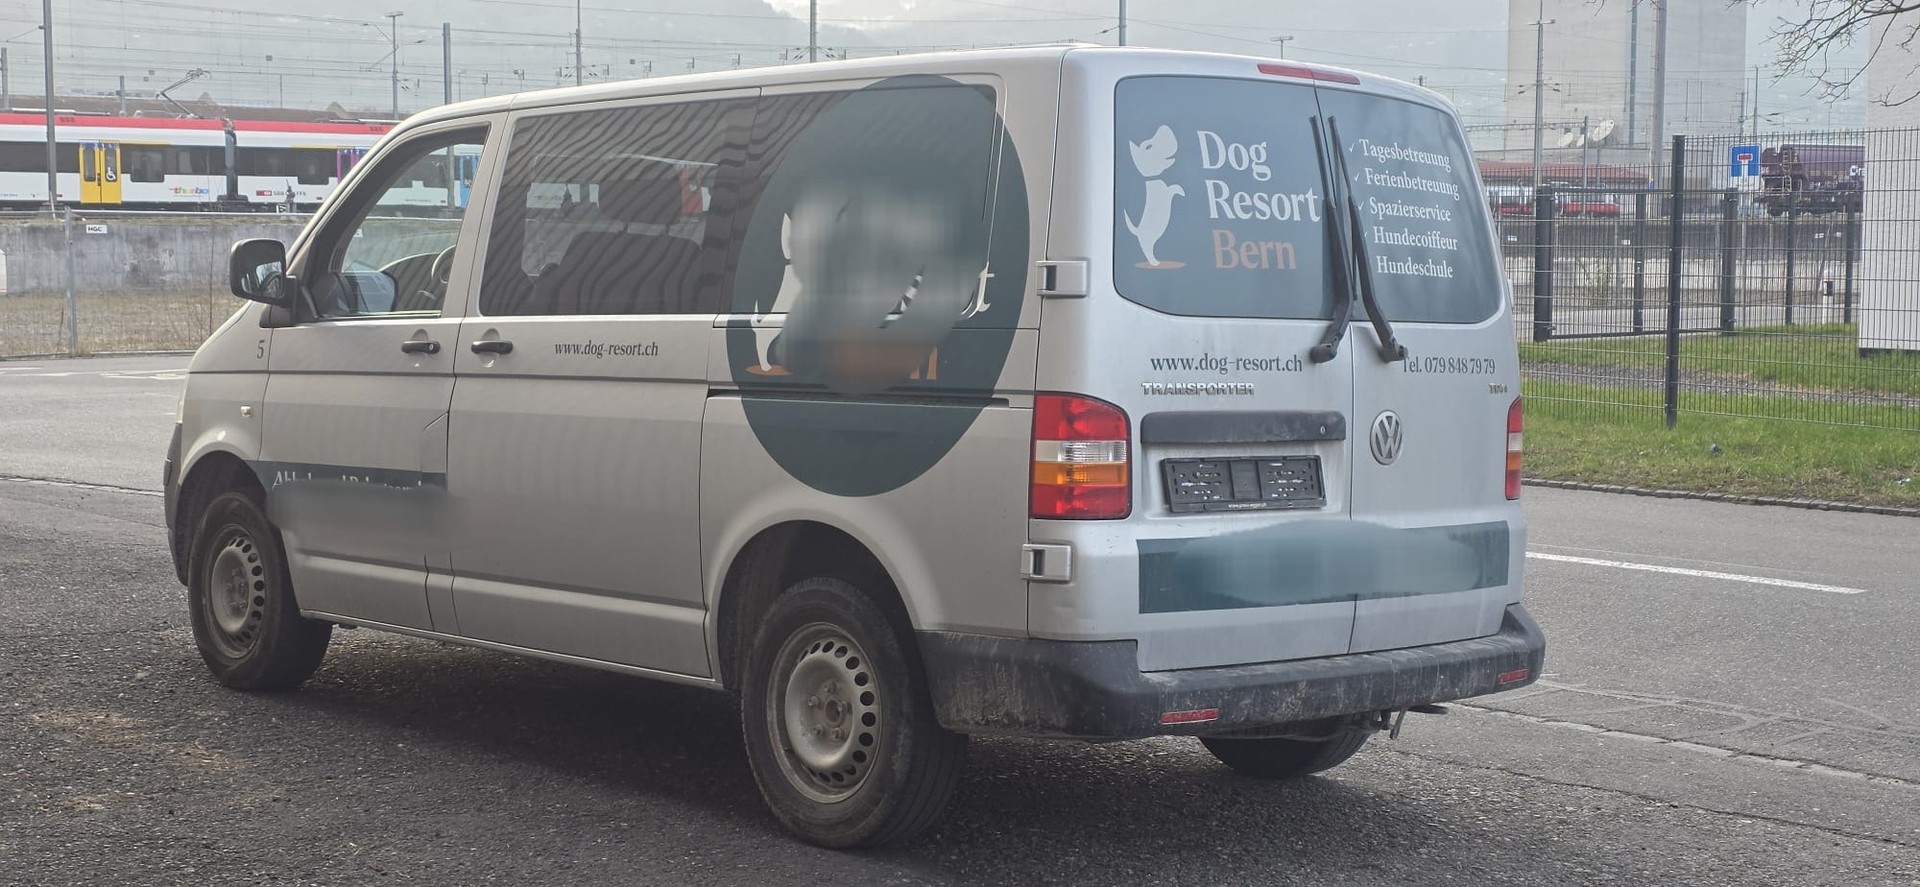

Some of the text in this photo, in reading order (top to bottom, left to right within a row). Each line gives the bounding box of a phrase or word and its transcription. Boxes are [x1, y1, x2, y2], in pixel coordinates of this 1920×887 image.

[1197, 130, 1271, 181] Dog
[1359, 139, 1451, 172] Tagesbetreuung
[1364, 167, 1459, 201] Ferienbetreuung
[1205, 180, 1321, 222] Resort
[1369, 196, 1451, 221] Spazierservice
[1212, 229, 1296, 270] Bern
[1373, 226, 1458, 250] Hundecoiffeur
[1376, 255, 1454, 278] Hundeschule
[257, 340, 265, 359] 5
[555, 339, 659, 359] www.dog-resort.ch
[1150, 353, 1303, 374] www.dog-resort.ch
[1425, 356, 1446, 373] 079
[1448, 357, 1468, 374] 848
[1470, 358, 1482, 374] 79
[1484, 359, 1496, 374] 79
[1141, 382, 1254, 396] TRANSPORTER
